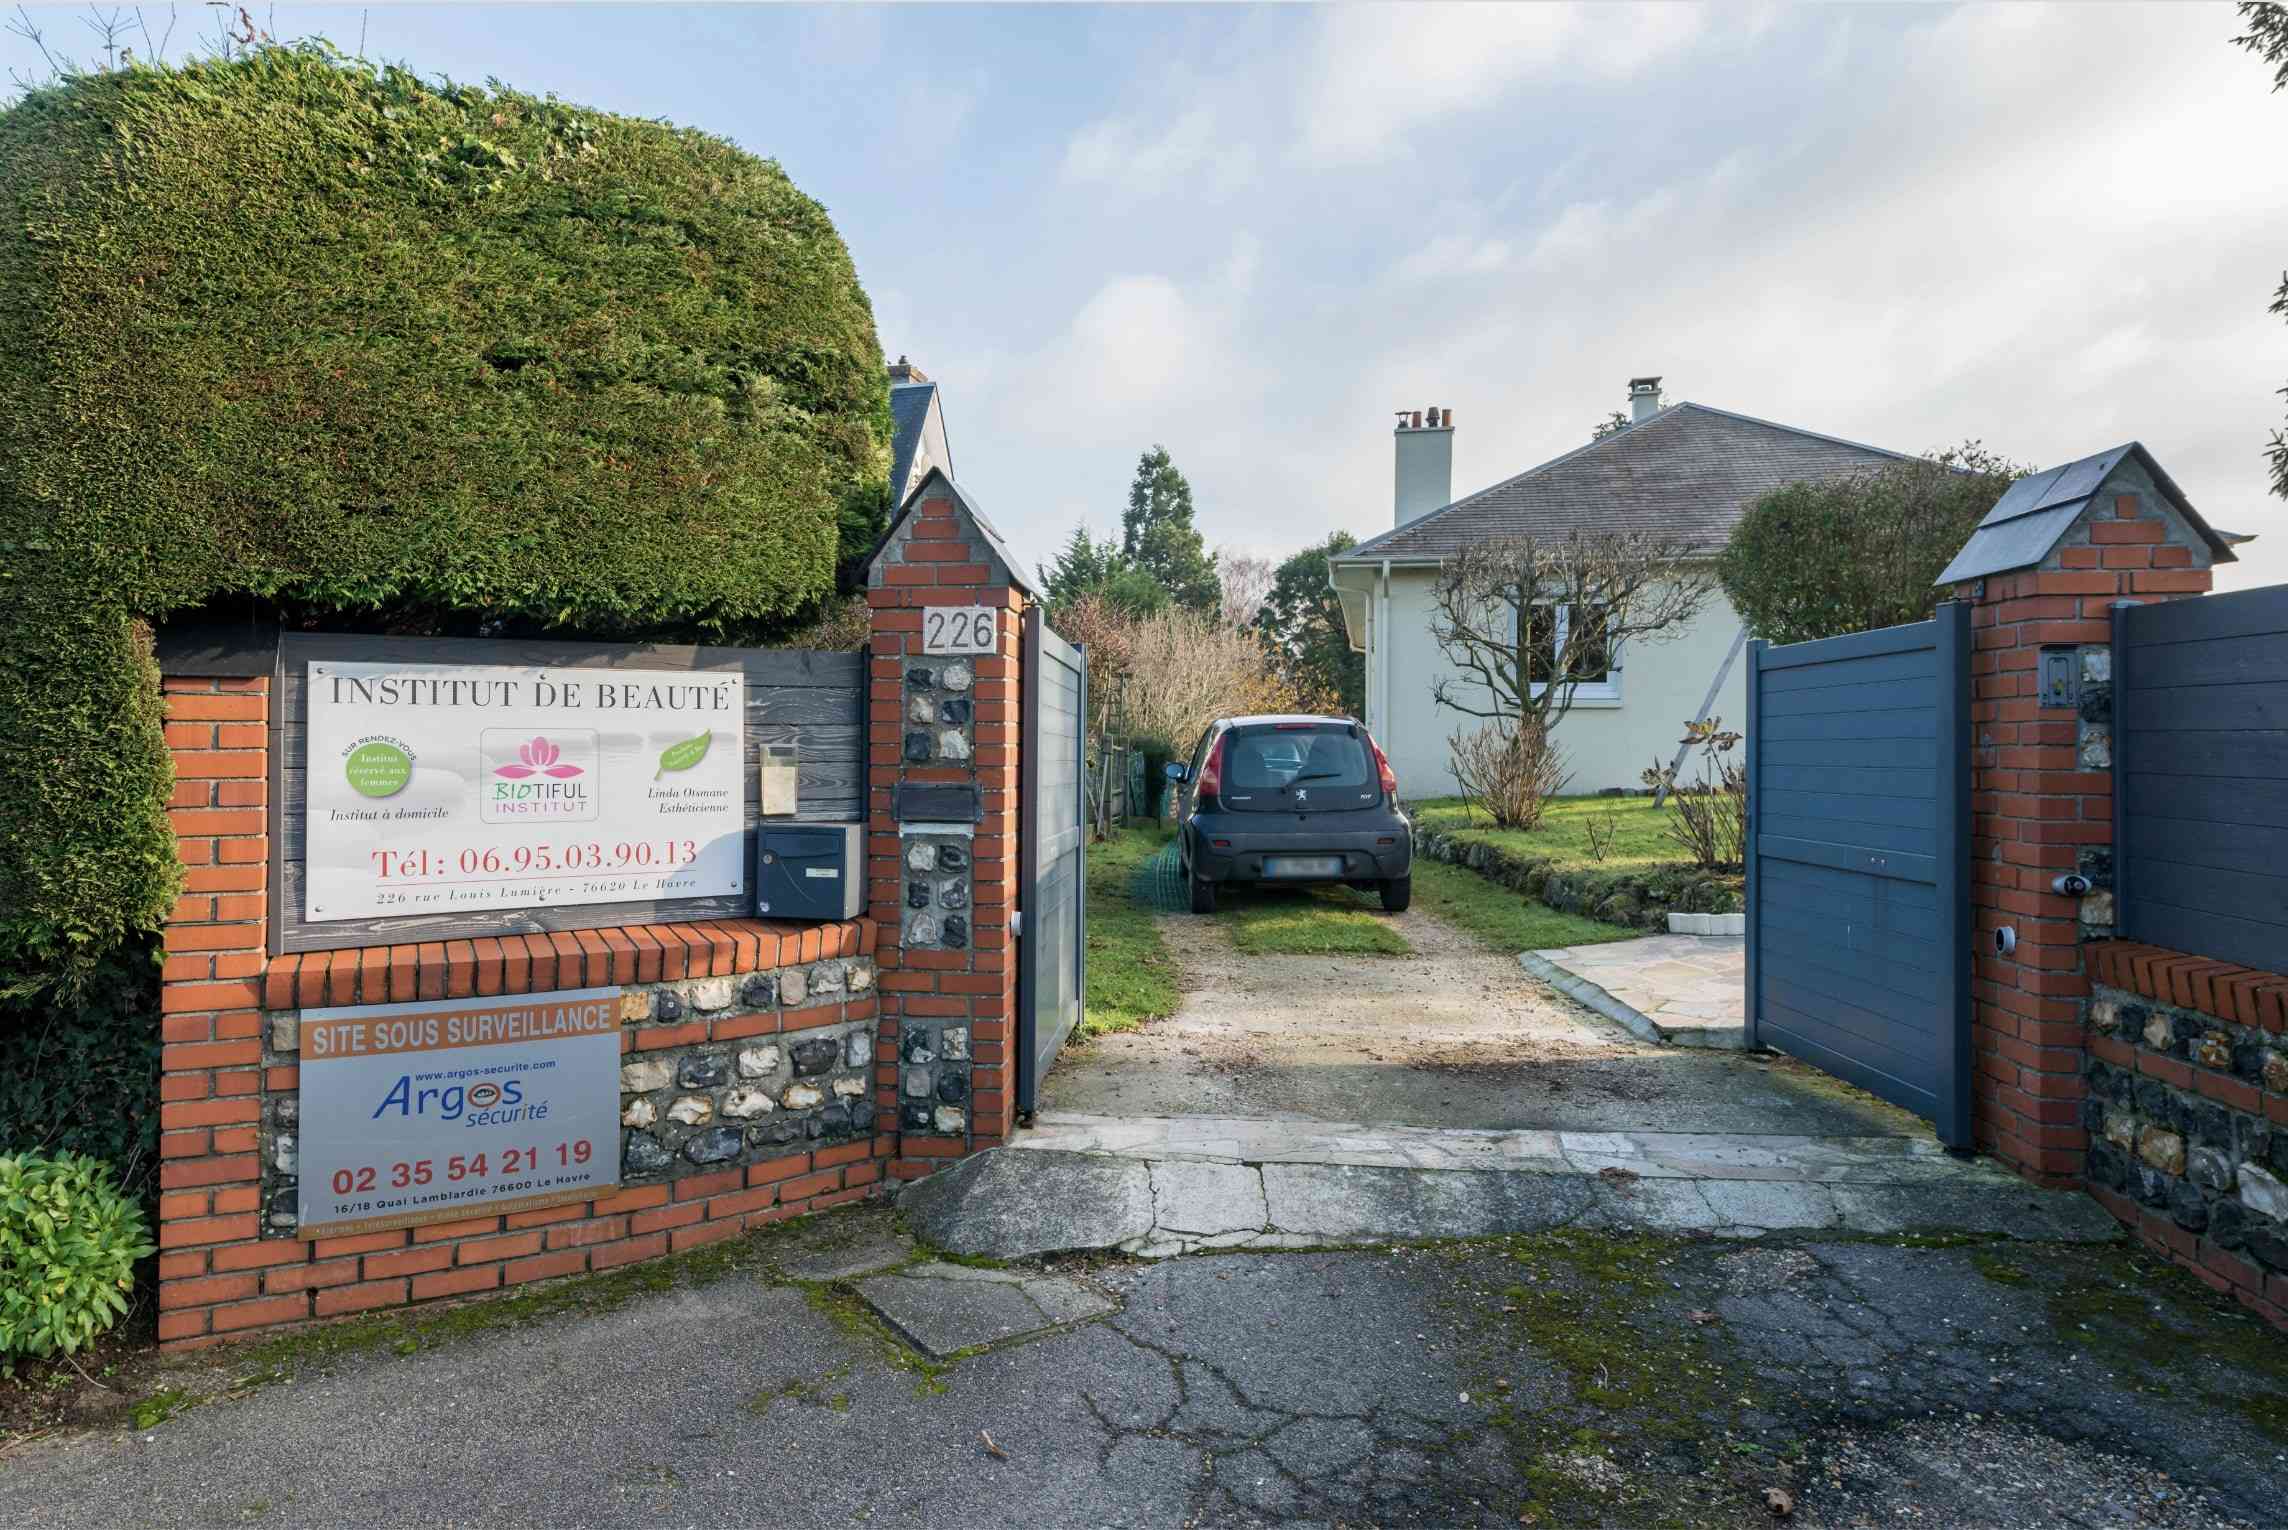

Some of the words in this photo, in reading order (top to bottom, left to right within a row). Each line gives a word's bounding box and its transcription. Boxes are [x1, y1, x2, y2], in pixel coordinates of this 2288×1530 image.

[927, 612, 993, 648] 226
[332, 676, 518, 707] INSTITUT
[534, 681, 582, 708] DE
[597, 680, 730, 711] BEAUTÉ
[341, 742, 357, 757] SUR
[358, 735, 417, 761] RENDEZ-VOUS
[360, 752, 399, 763] Institut
[492, 782, 587, 800] BIOTIFUL
[648, 787, 679, 799] Linda
[330, 808, 378, 821] Institut
[382, 809, 391, 820] à
[395, 807, 449, 820] domicile
[496, 801, 588, 813] INSTITUT
[659, 802, 729, 814] Esthéticienne
[459, 840, 698, 874] 06.95.03.90.13
[415, 893, 441, 902] rue
[450, 888, 491, 900] Louis
[500, 884, 561, 898] Lumière
[583, 881, 626, 894] 76620
[633, 879, 649, 890] Le
[656, 878, 697, 889] Havre
[312, 1023, 369, 1055] SITE
[375, 1018, 439, 1049] SOUS
[447, 1003, 611, 1044] SURVEILLANCE
[415, 1058, 557, 1082] www.argos-securite.com
[372, 1075, 523, 1120] Argos
[465, 1100, 549, 1128] sécurité
[332, 1167, 377, 1196] 02
[391, 1159, 433, 1188] 35
[447, 1152, 489, 1182] 54
[501, 1146, 537, 1175] 21
[555, 1139, 593, 1167] 19
[334, 1201, 371, 1215] 16/18
[491, 1180, 532, 1194] 76600
[537, 1177, 551, 1188] Le
[556, 1173, 591, 1185] Havre
